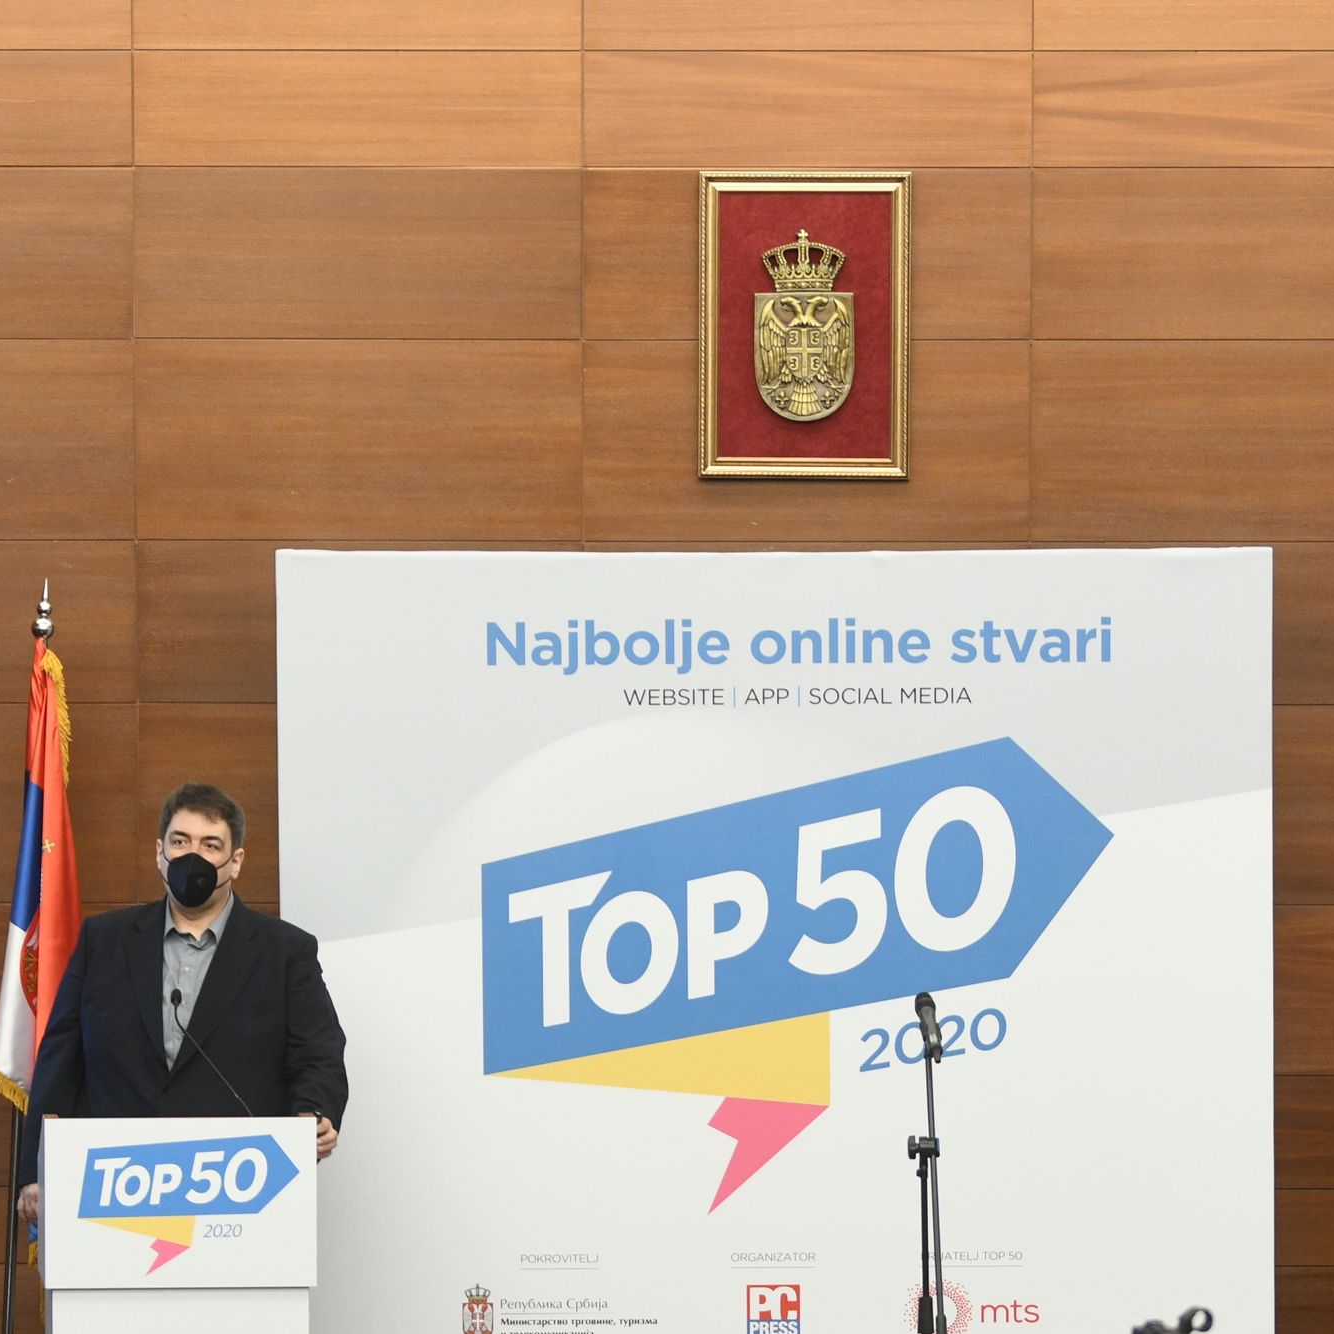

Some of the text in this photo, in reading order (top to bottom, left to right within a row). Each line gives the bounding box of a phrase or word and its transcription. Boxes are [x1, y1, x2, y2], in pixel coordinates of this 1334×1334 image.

[486, 616, 1112, 676] Najbolje online stvari
[623, 687, 972, 706] WEBSITE APP SOCIAL MEDIA
[508, 785, 1017, 1028] TOP 50
[859, 1006, 1008, 1074] 2020
[94, 1147, 268, 1207] TOP 50
[203, 1223, 243, 1238] 2020
[520, 1253, 599, 1265] POKROVITELJ
[730, 1251, 816, 1263] ORGANIZATOR
[984, 1250, 1006, 1262] TOP
[1009, 1250, 1023, 1262] 50
[500, 1297, 608, 1315] Република Србија
[750, 1286, 798, 1321] PC
[981, 1299, 1040, 1324] mts
[500, 1316, 658, 1329] Министарство трговине, туризма
